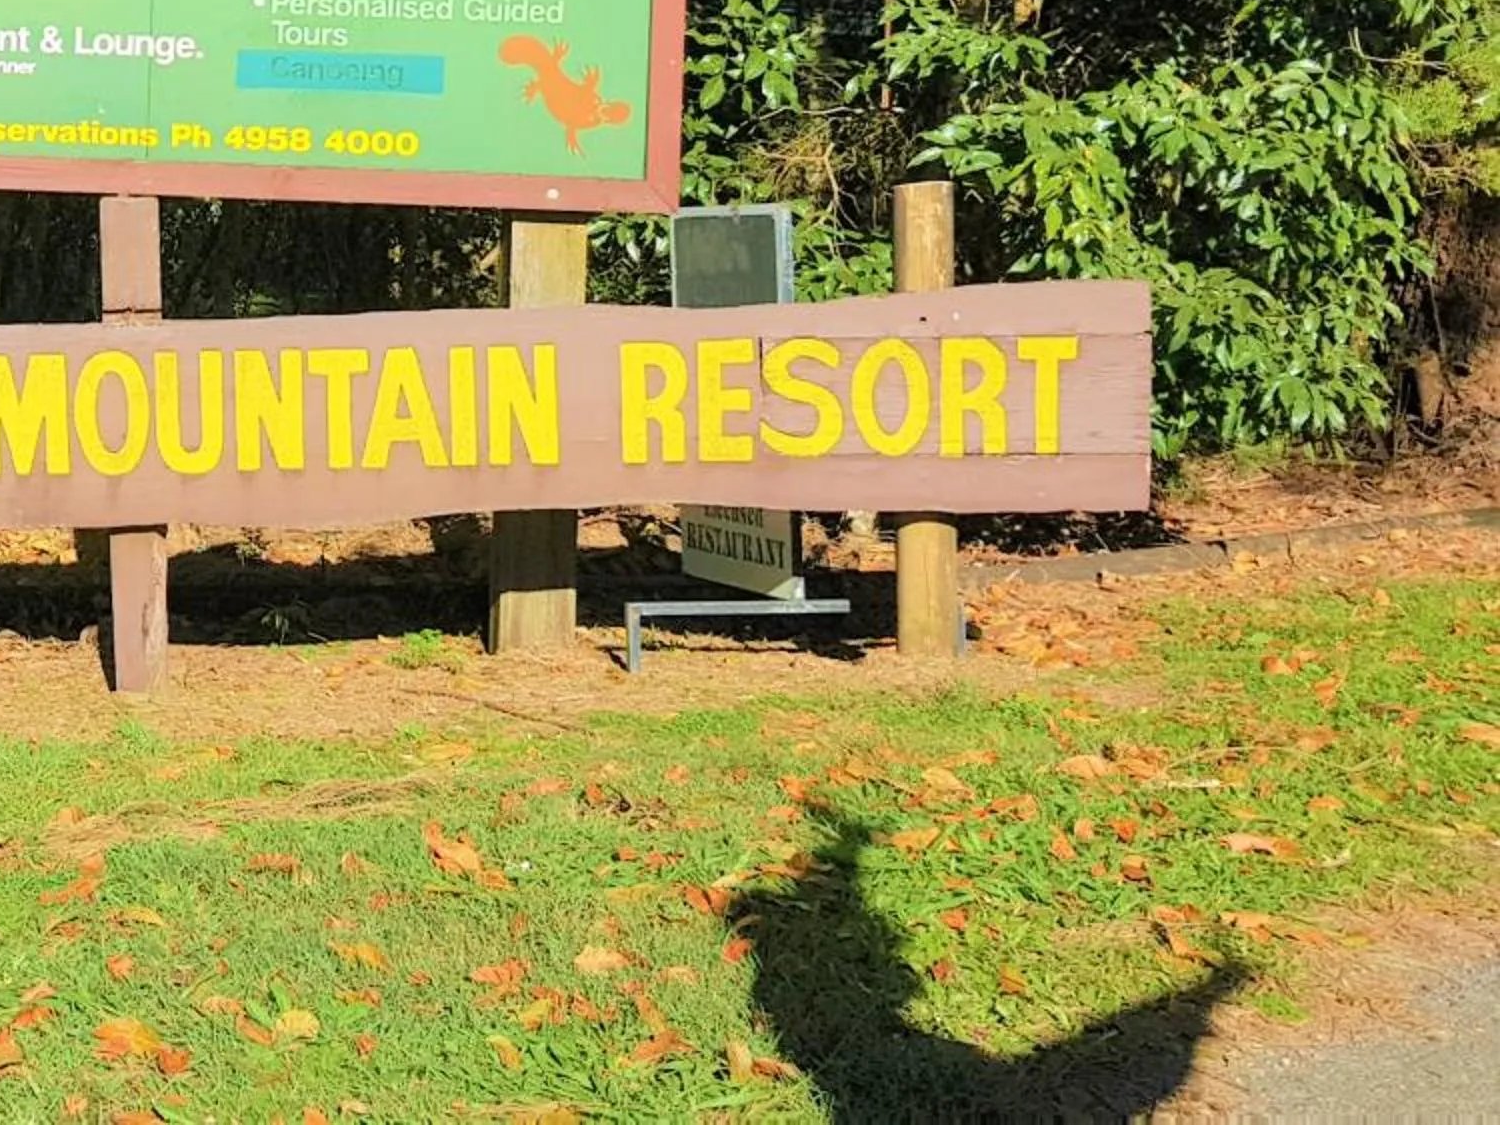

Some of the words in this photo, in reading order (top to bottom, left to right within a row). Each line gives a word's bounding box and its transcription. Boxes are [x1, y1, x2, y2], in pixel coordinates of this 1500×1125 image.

[40, 25, 63, 53] &
[74, 26, 205, 64] Lounge.
[273, 21, 348, 46] Tours
[271, 56, 404, 88] Canoeing
[170, 123, 211, 148] Ph
[224, 126, 312, 152] 4958
[324, 129, 420, 156] 4000
[619, 335, 1079, 464] RESORT
[687, 523, 785, 569] RESTAURANT
